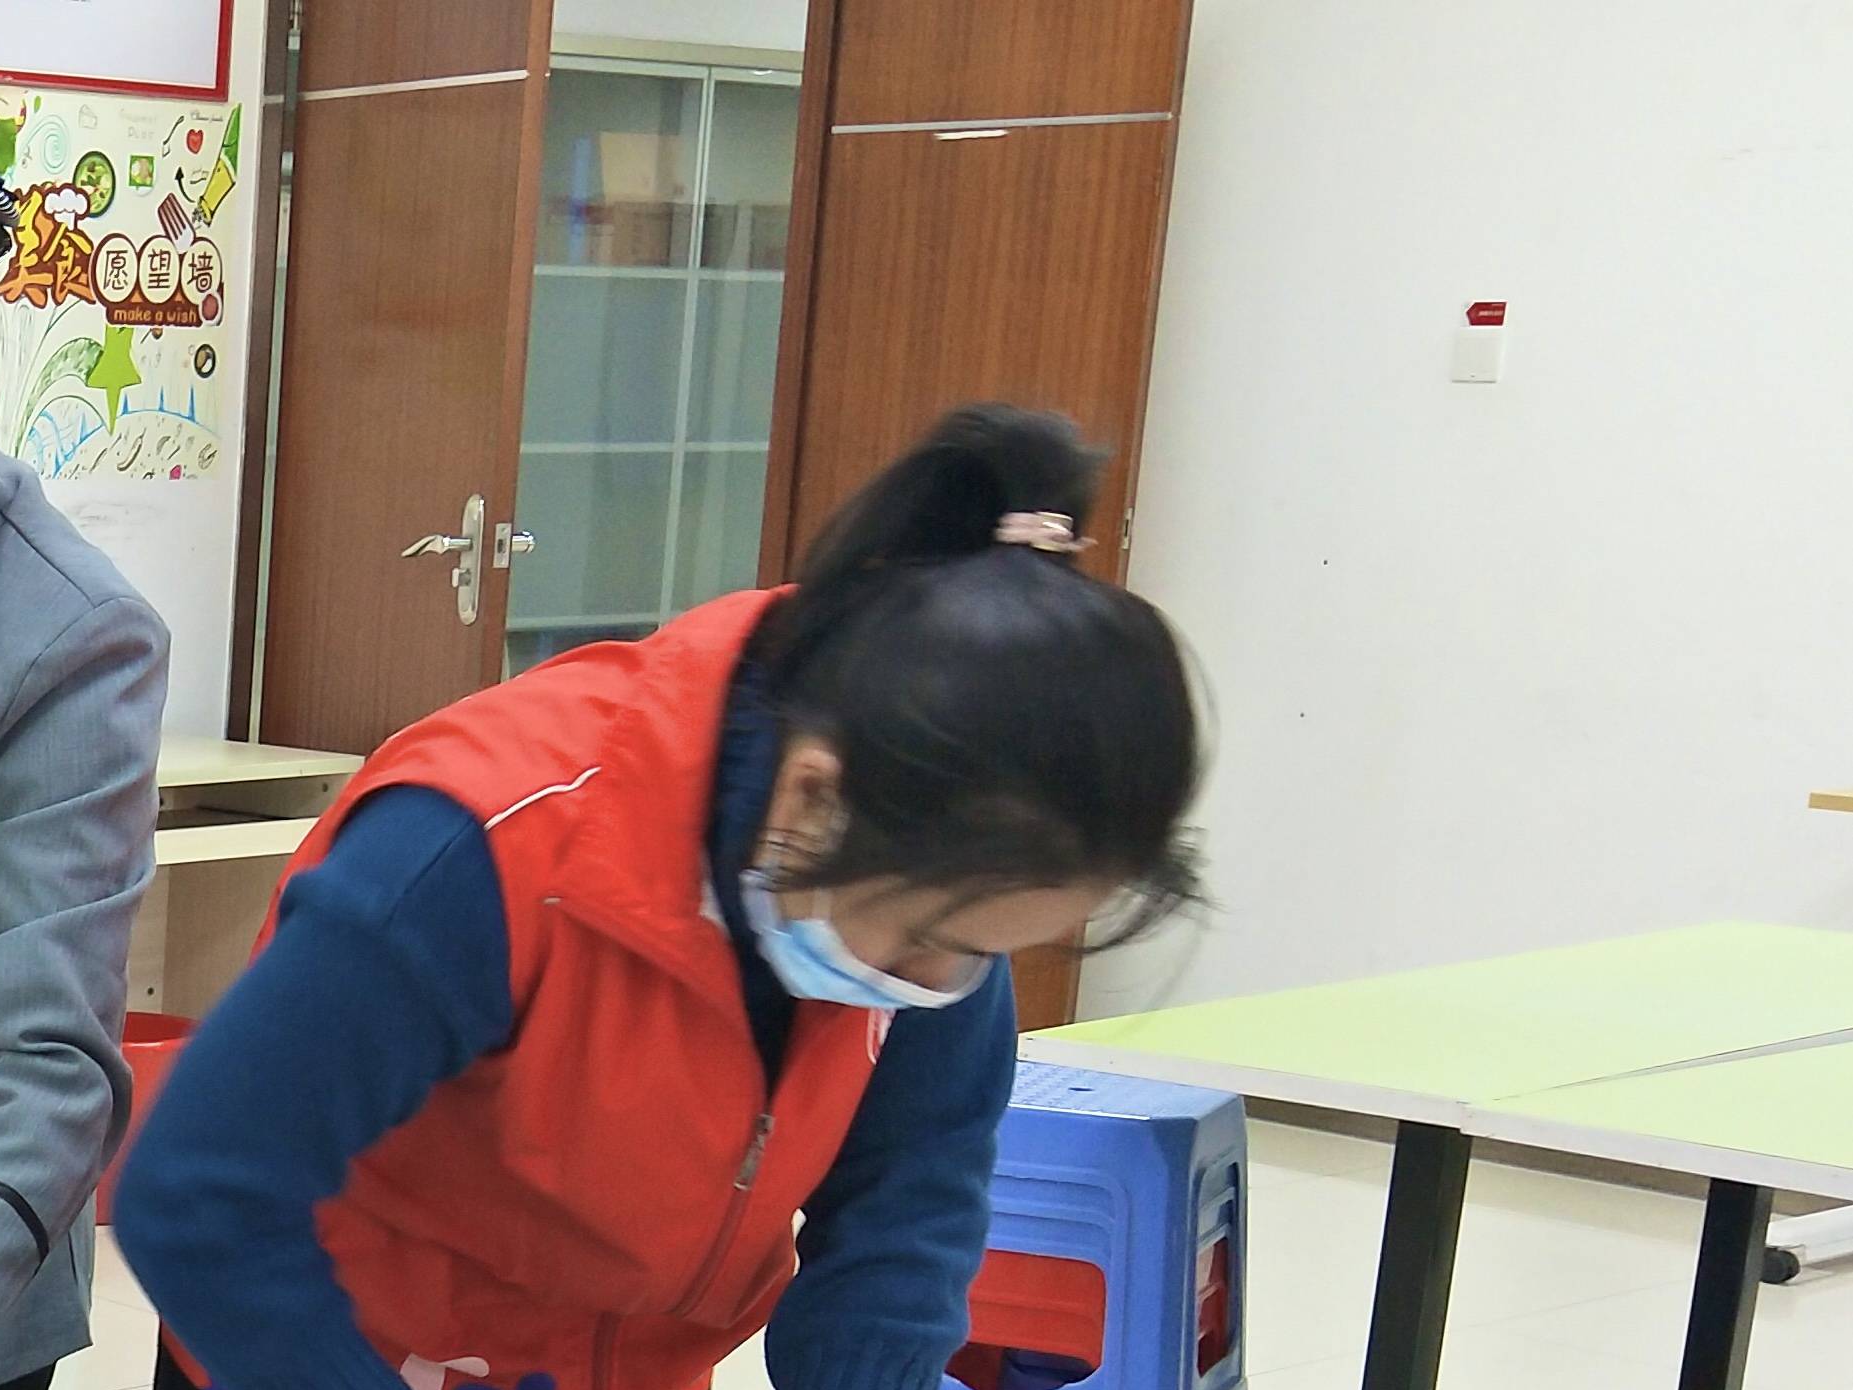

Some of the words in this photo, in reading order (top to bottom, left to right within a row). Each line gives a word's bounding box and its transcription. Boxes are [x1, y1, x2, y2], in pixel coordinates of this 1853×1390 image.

[103, 248, 214, 293] 愿望墙
[114, 305, 152, 321] make
[155, 309, 164, 321] a
[167, 307, 198, 324] wish
